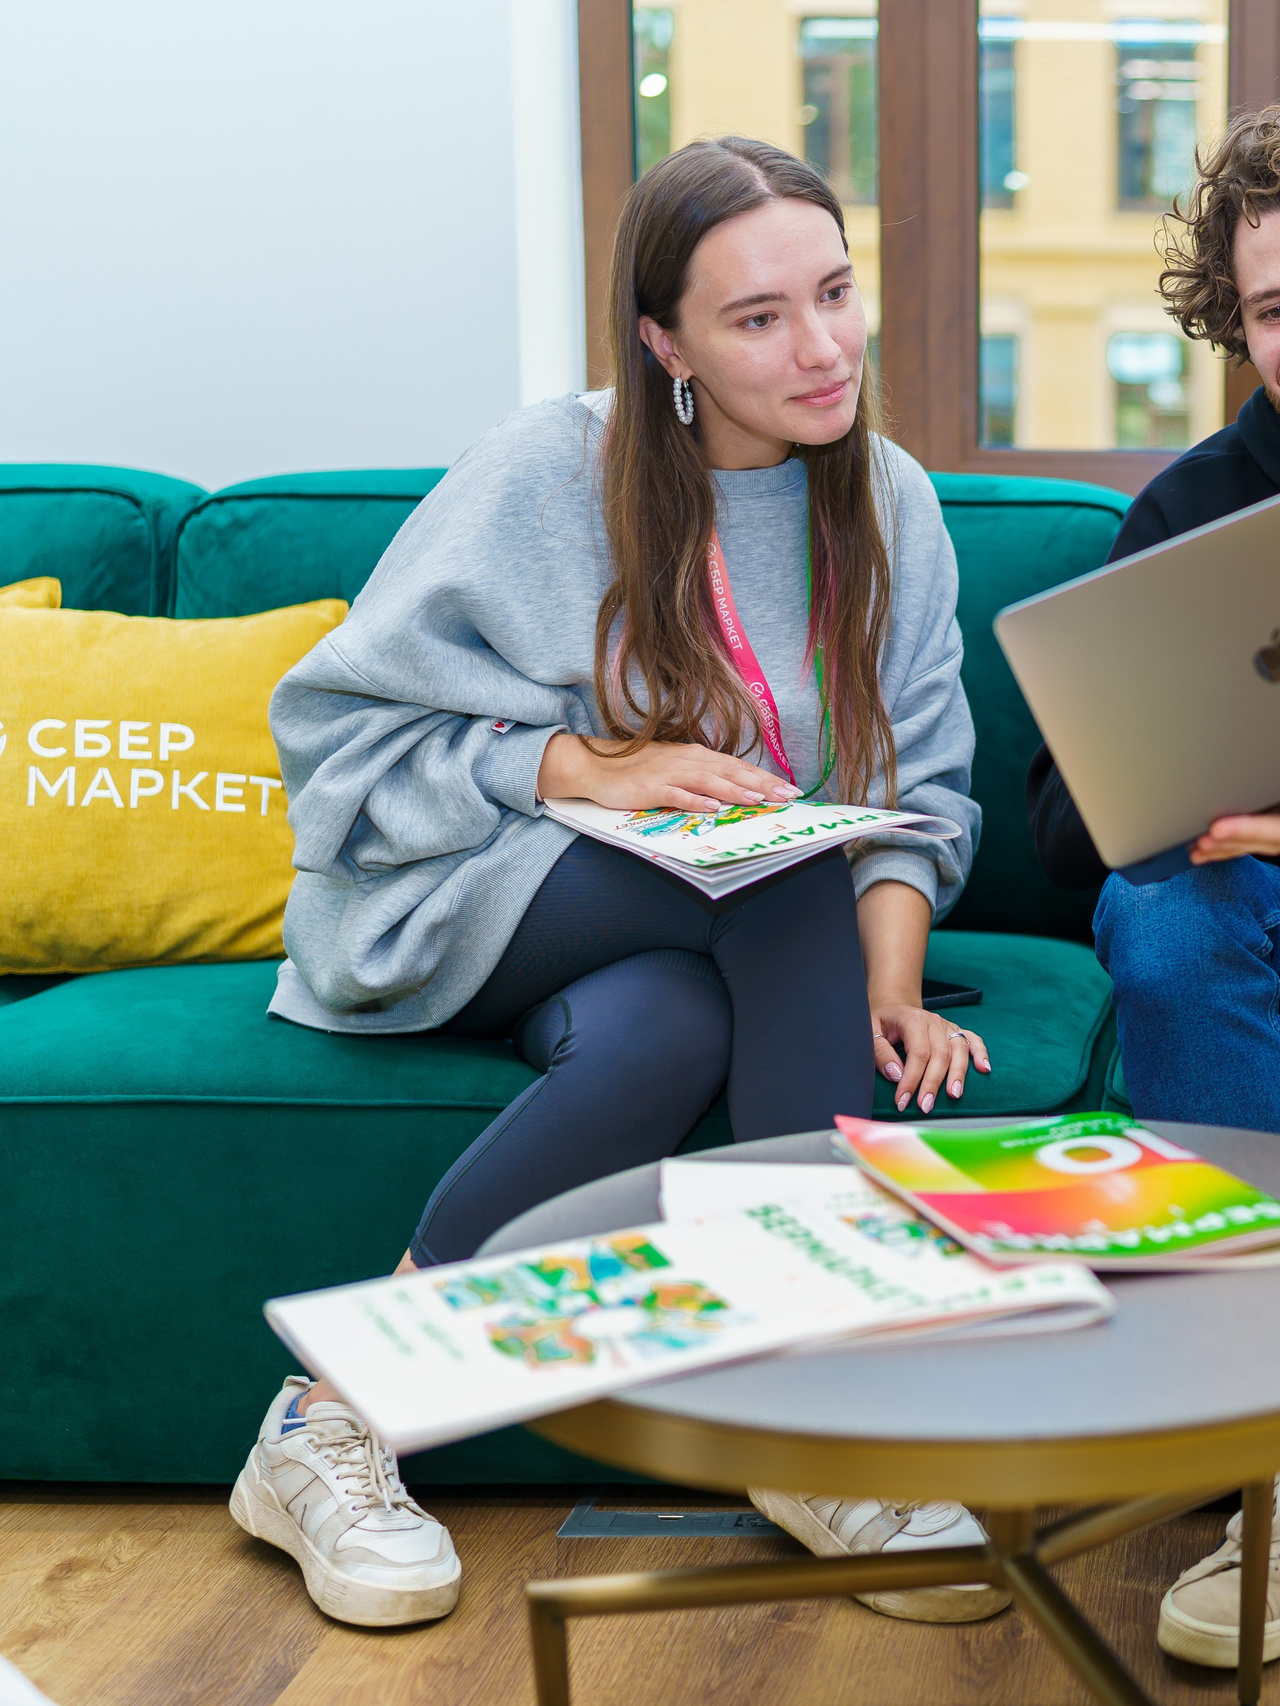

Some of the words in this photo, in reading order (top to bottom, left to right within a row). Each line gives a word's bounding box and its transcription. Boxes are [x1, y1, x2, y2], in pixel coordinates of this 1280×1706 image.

[708, 560, 724, 596] СБЕР
[717, 597, 743, 650] МАРКЕТ
[27, 718, 195, 761] СБЕР
[27, 766, 282, 816] МАРКЕТ
